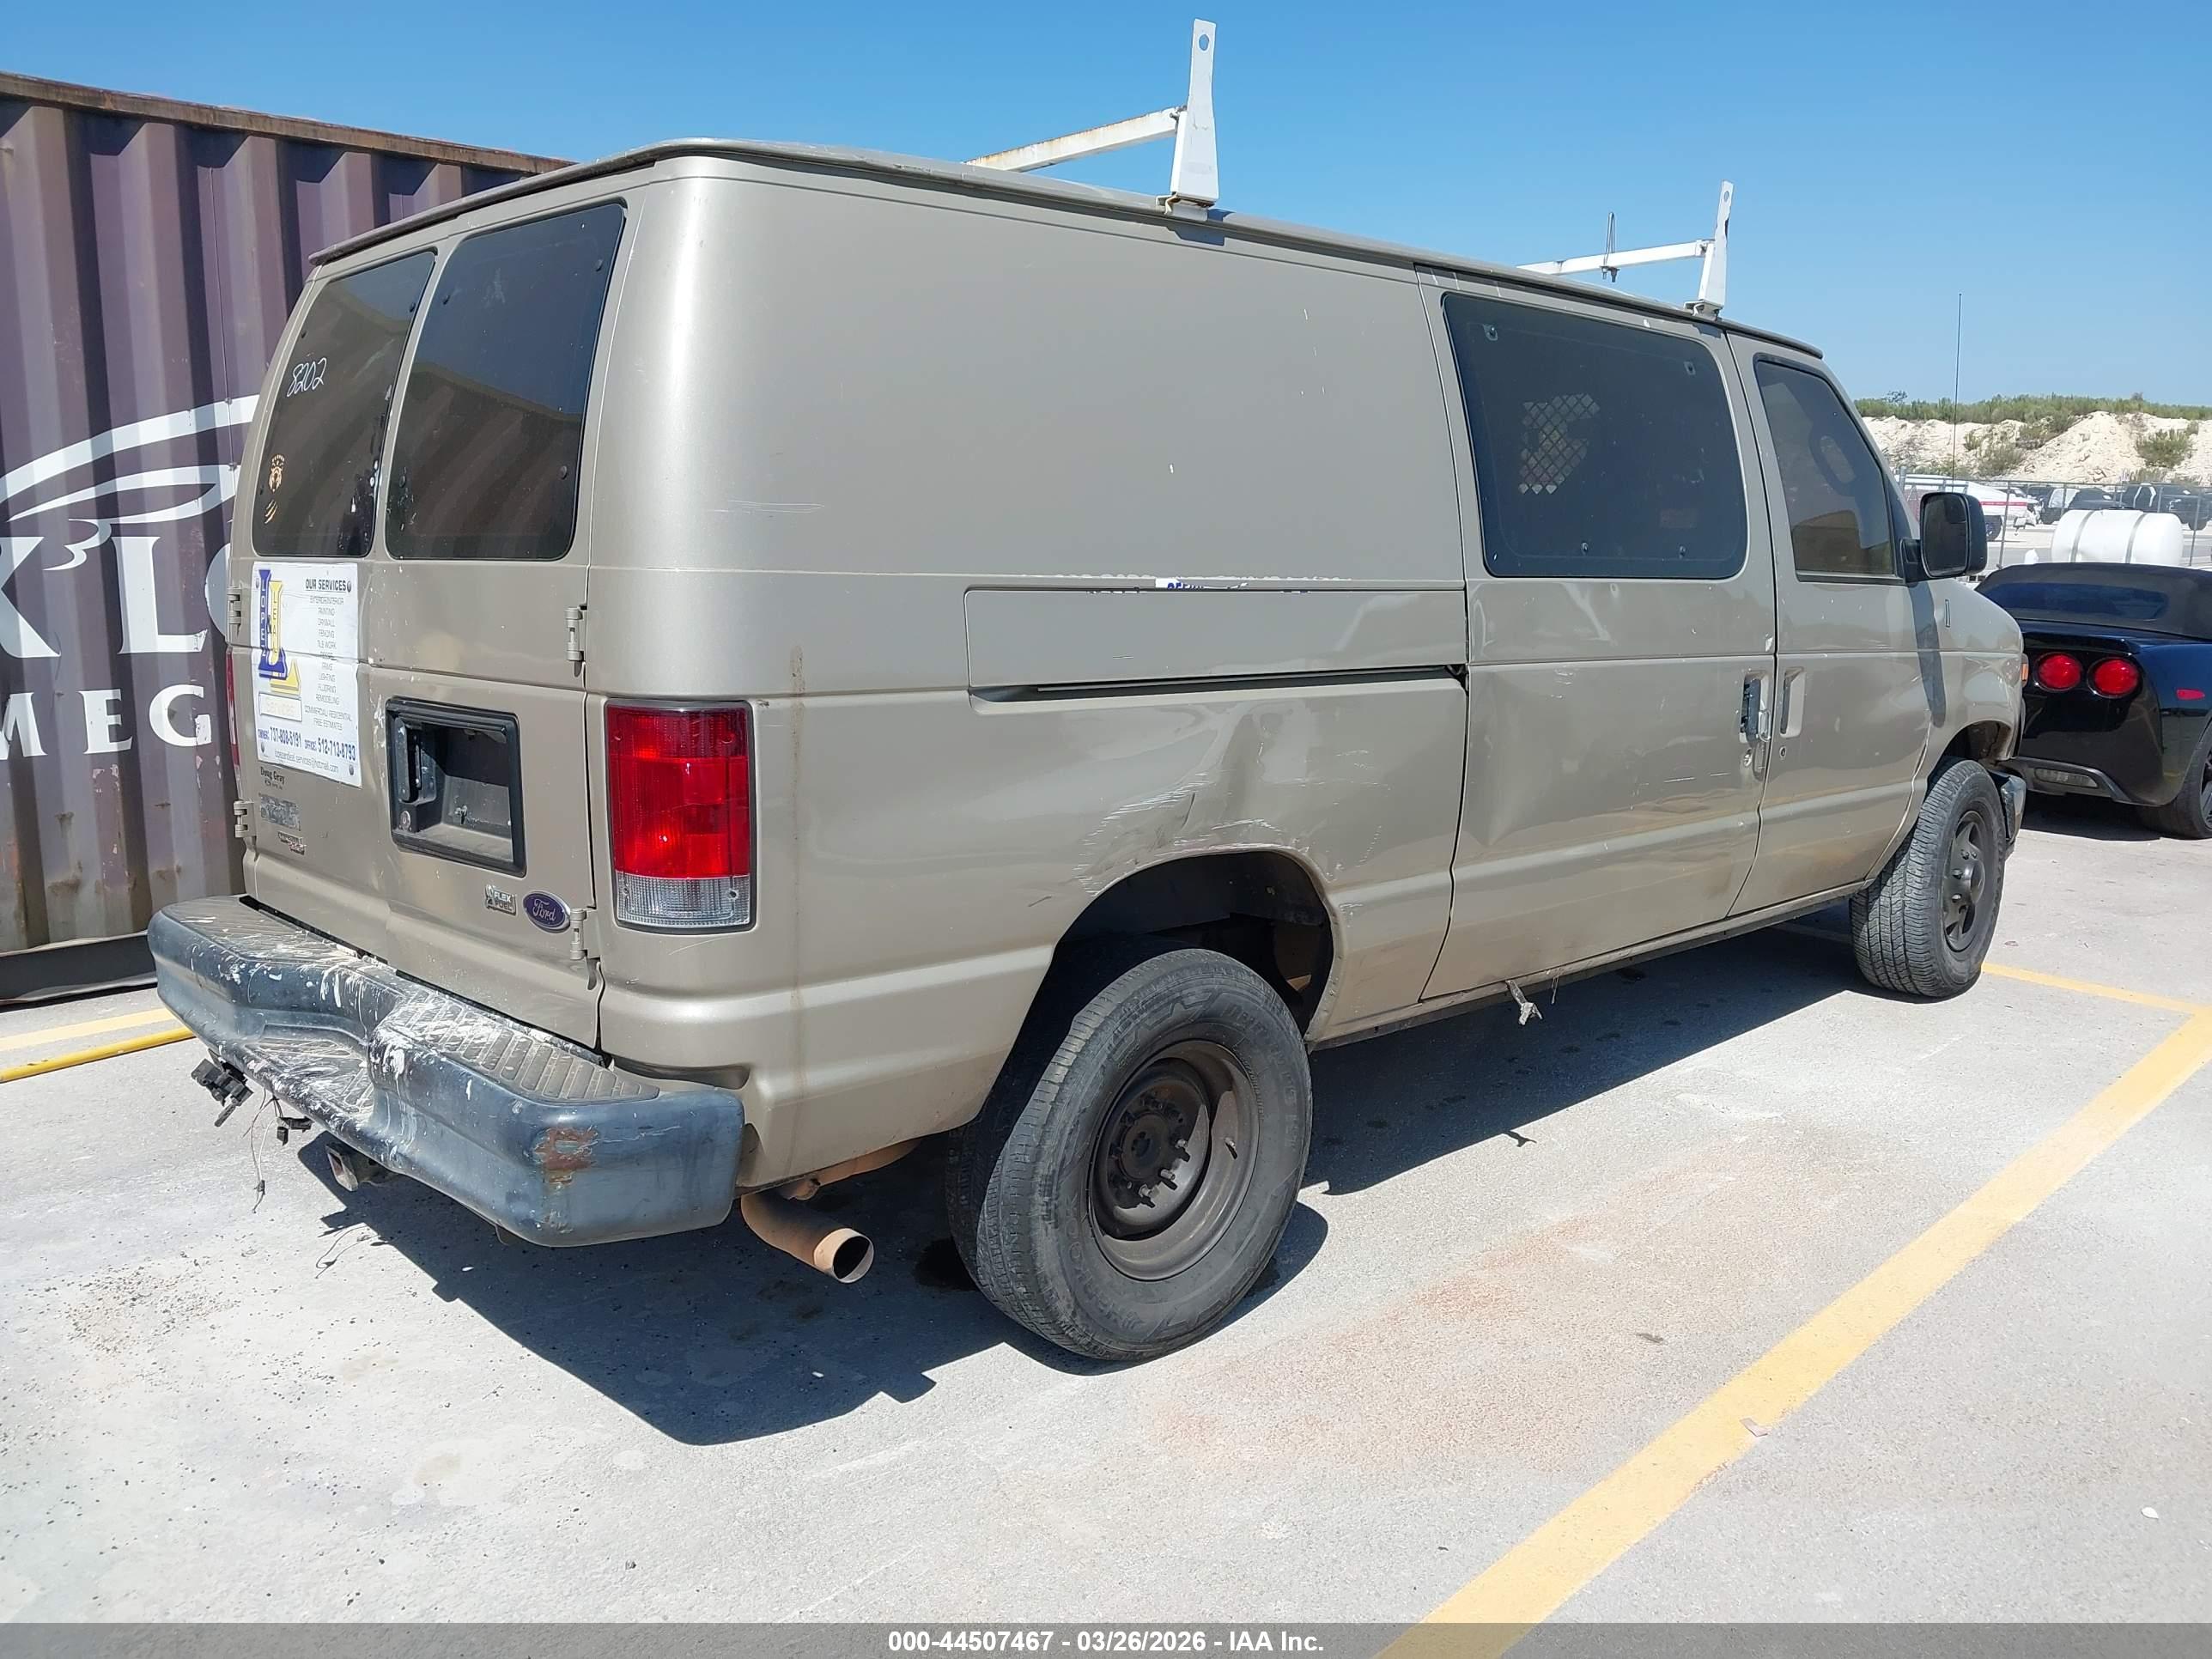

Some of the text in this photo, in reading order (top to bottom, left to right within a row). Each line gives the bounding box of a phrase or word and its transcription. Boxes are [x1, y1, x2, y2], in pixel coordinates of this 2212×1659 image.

[306, 579, 346, 591] OUR SERVICES
[318, 736, 356, 762] 512-713-8793
[494, 890, 512, 902] FLEX
[495, 901, 513, 912] FUEL
[532, 898, 556, 921] Ford
